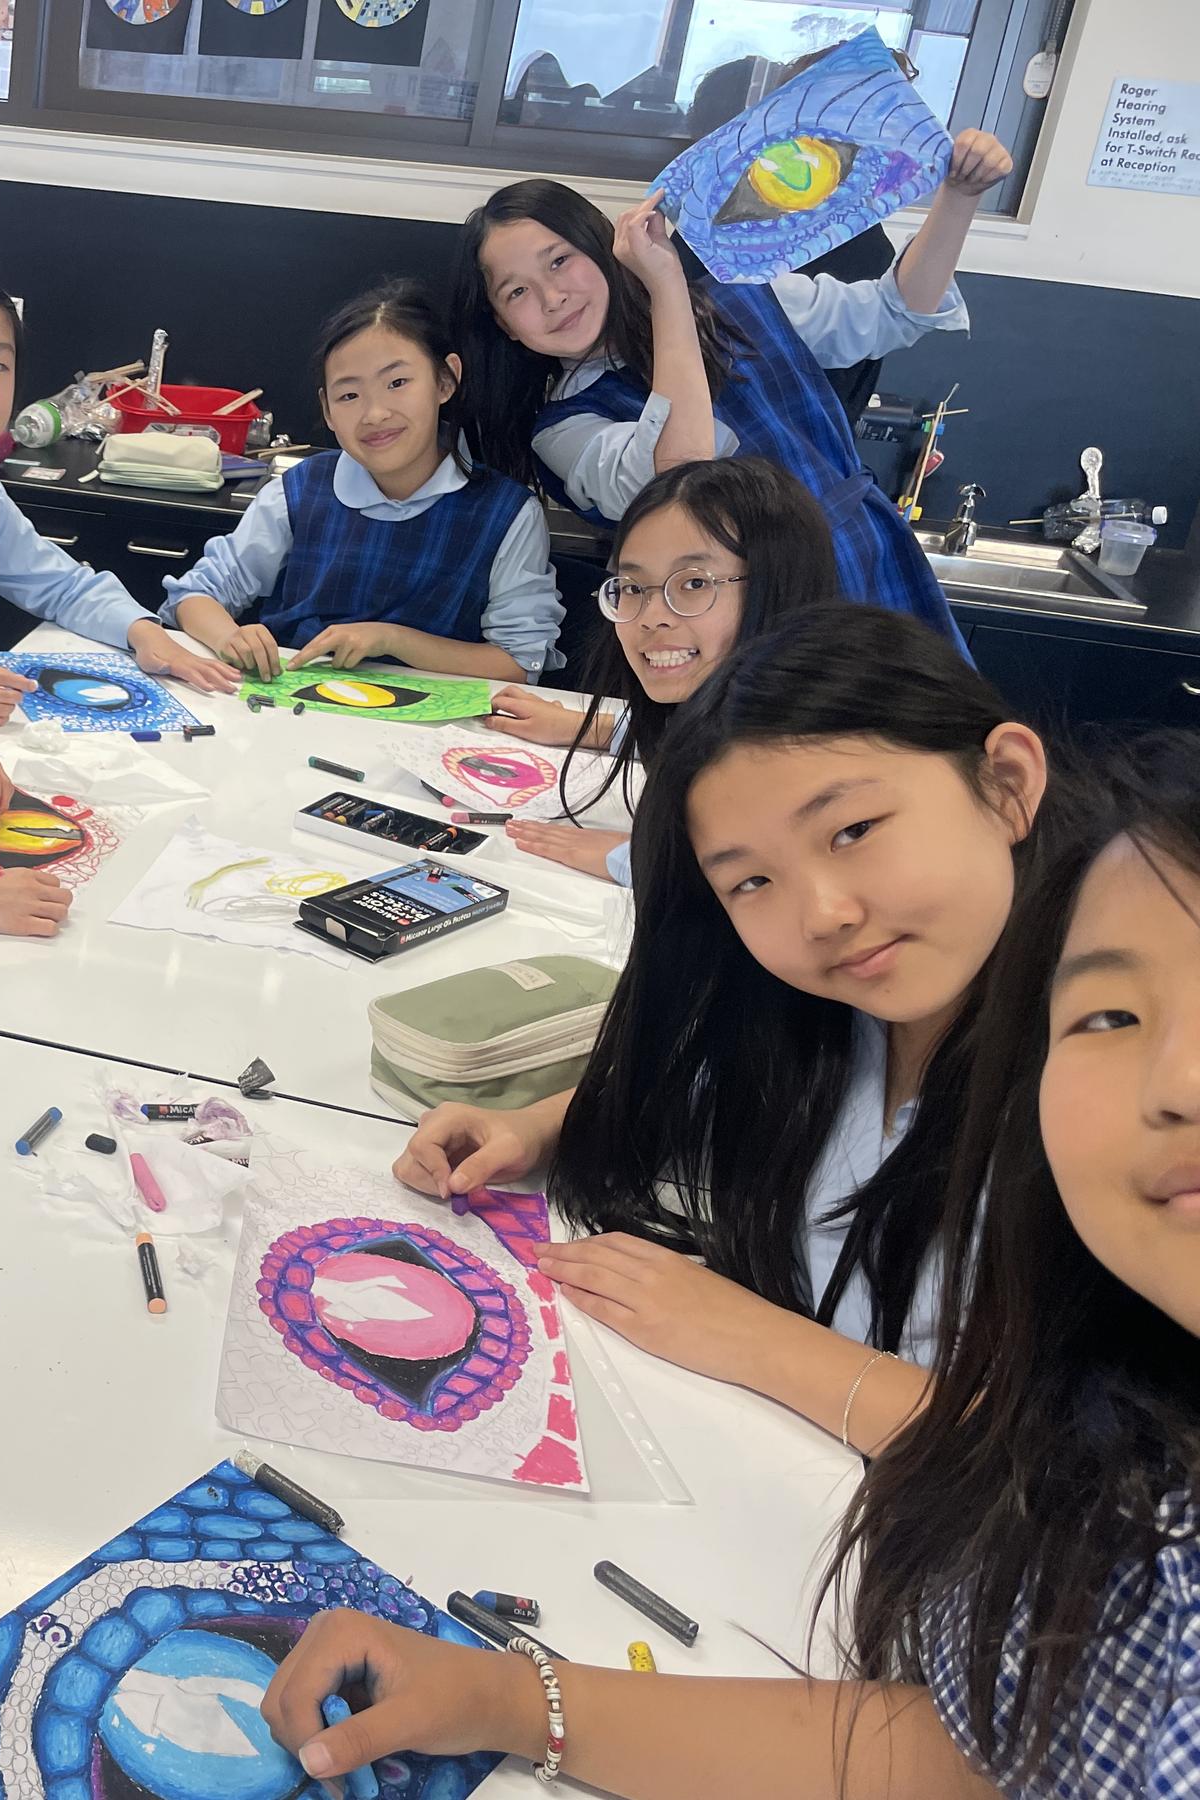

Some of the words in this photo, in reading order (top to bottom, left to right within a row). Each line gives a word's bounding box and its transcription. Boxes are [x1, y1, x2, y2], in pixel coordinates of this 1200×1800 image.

[1120, 83, 1158, 98] Roger
[1116, 98, 1167, 115] Hearing
[1112, 113, 1156, 127] System
[1108, 127, 1164, 144] Installed,
[1166, 133, 1189, 145] ask
[1105, 141, 1124, 153] for
[1127, 143, 1177, 159] T-Switch
[1100, 157, 1113, 167] at
[1116, 157, 1176, 174] Reception
